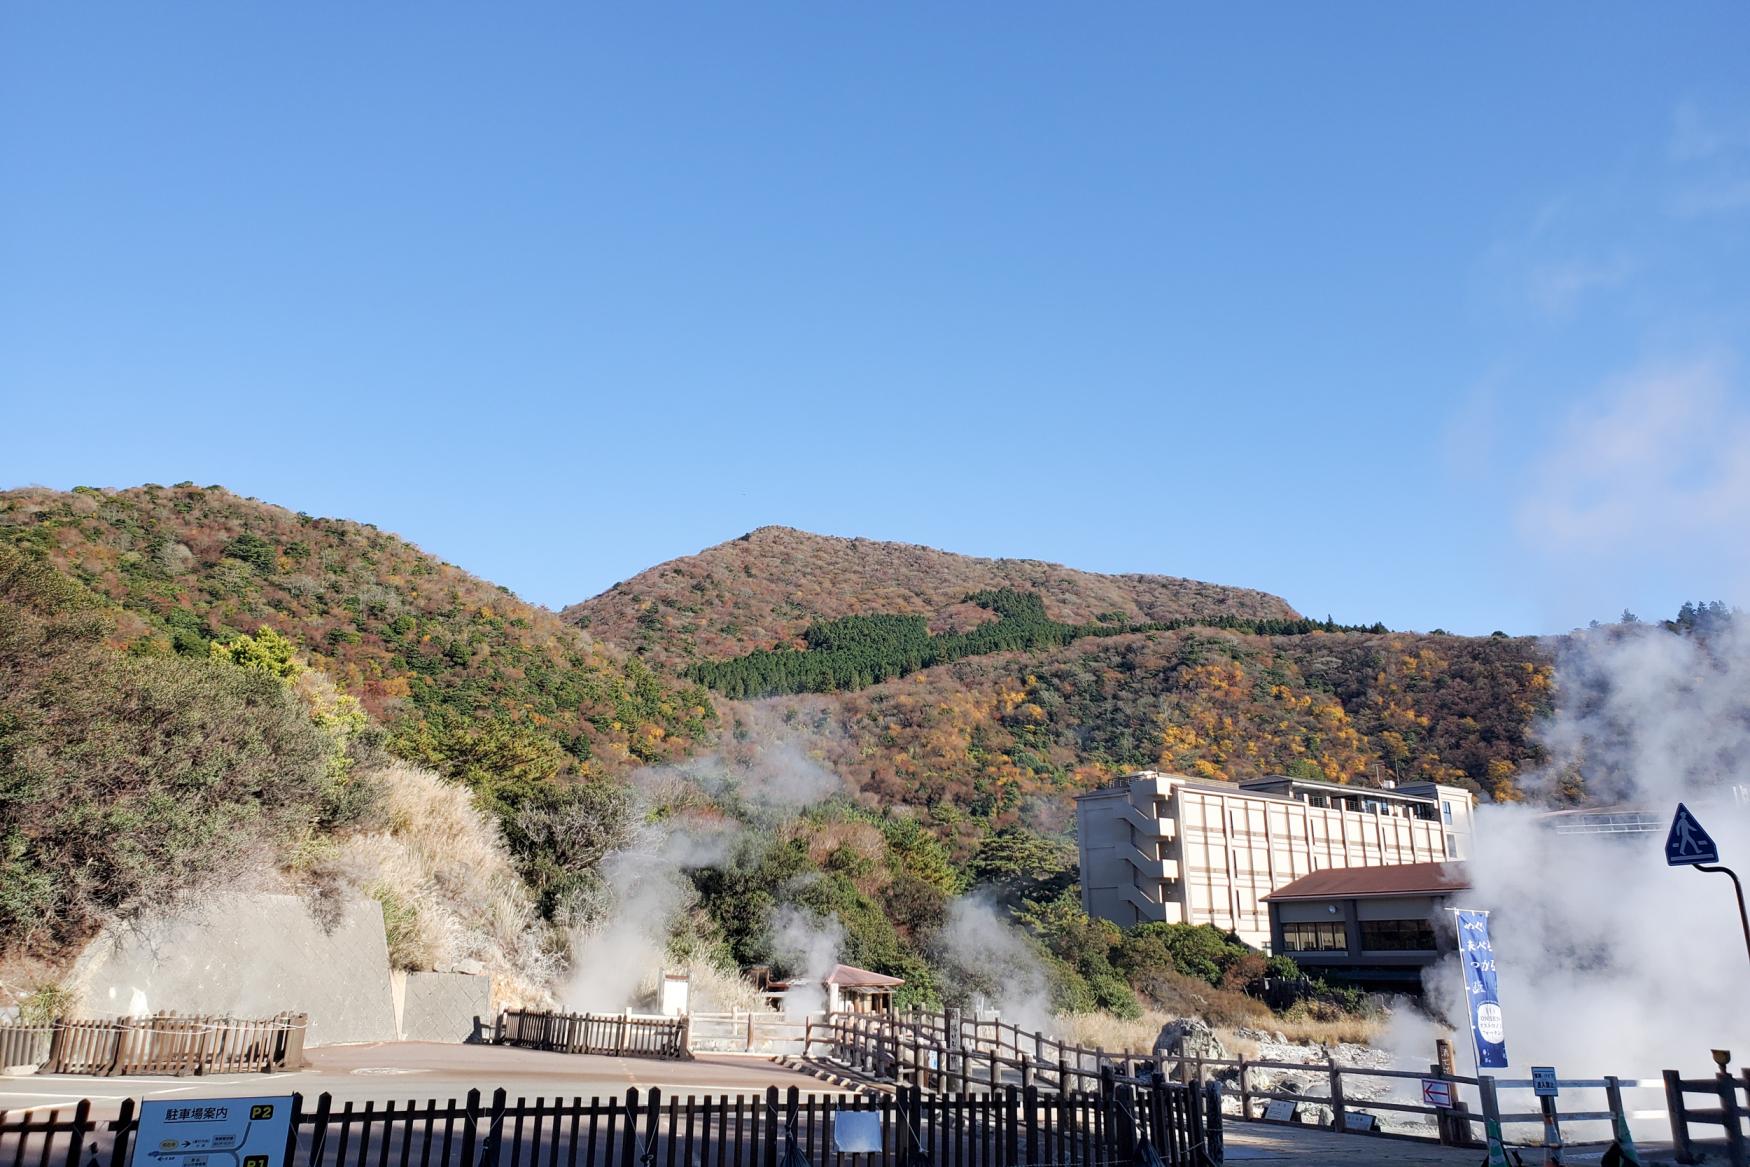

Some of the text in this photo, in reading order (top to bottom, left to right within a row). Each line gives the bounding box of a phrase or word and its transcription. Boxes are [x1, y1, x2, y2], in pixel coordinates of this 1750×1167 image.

[165, 1107, 228, 1121] 駐車場案内
[251, 1106, 272, 1119] P2
